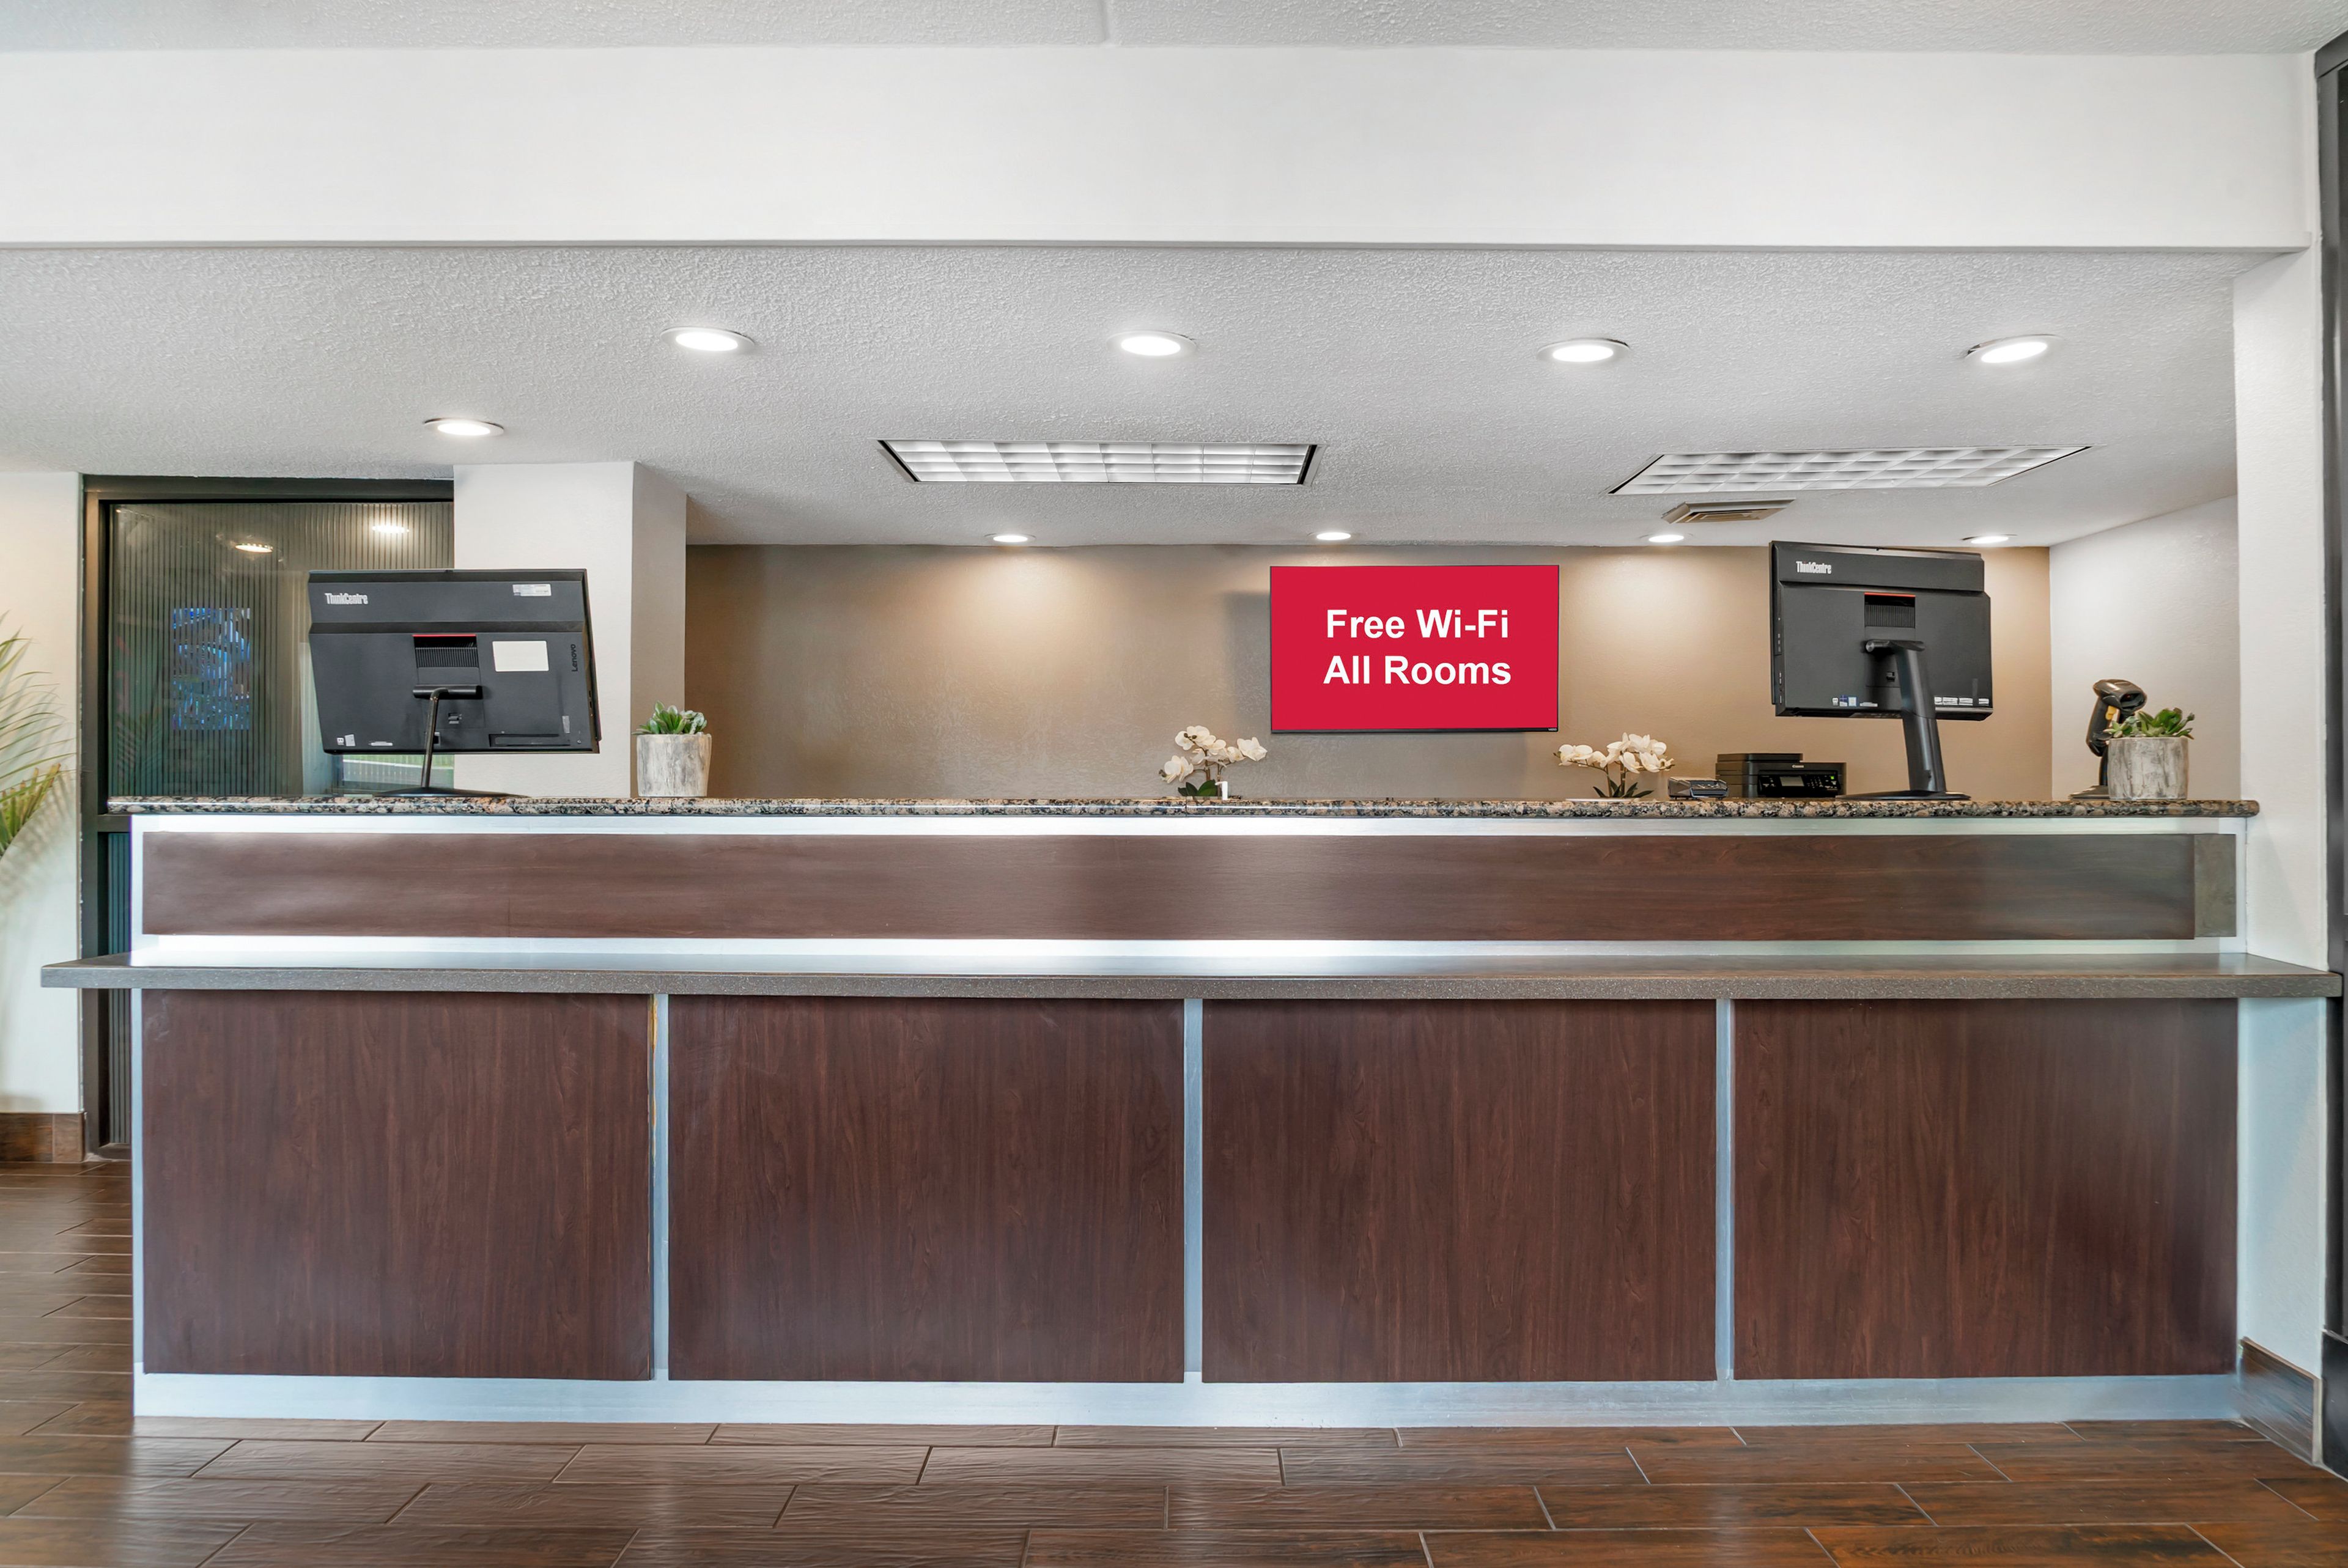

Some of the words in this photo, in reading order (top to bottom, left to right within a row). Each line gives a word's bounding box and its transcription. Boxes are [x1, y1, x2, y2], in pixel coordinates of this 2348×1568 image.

[1796, 561, 1832, 574] ThinkCentre
[324, 592, 369, 605] ThinkCentre
[1327, 609, 1405, 639] Free
[1416, 609, 1508, 639] Wi-Fi
[570, 644, 578, 672] Lenovo
[1323, 655, 1370, 685] All
[1385, 655, 1512, 685] Rooms
